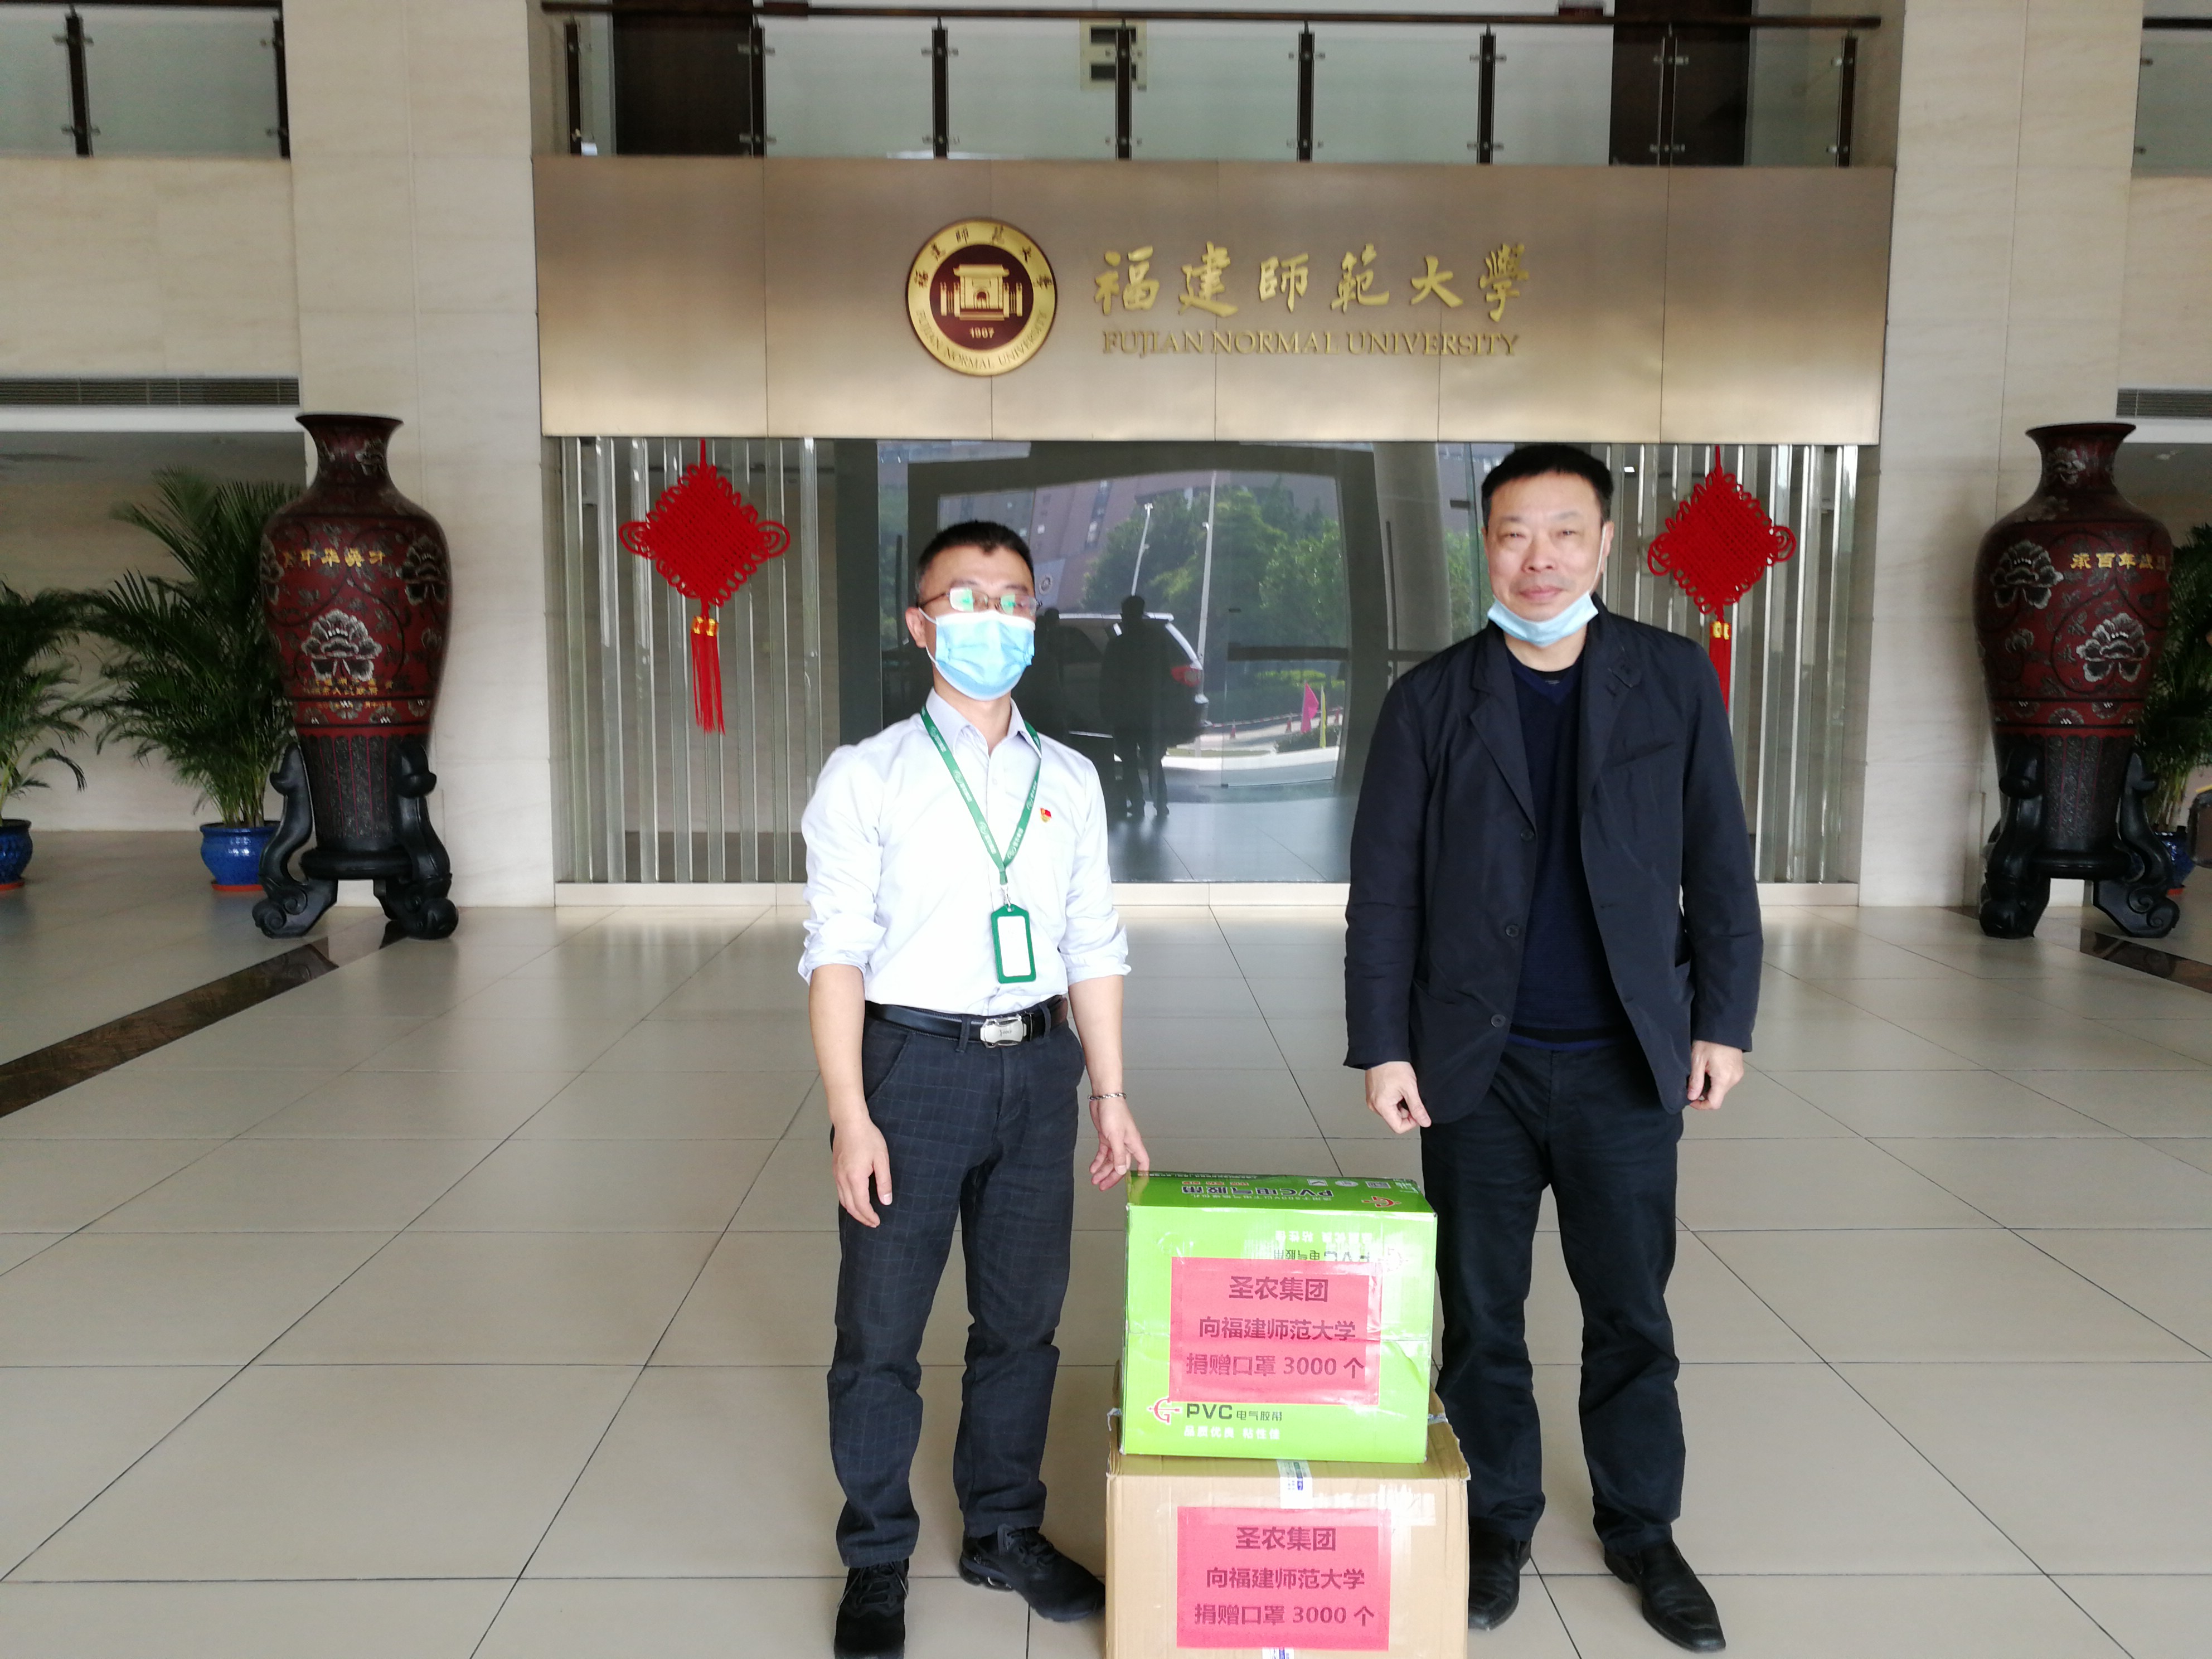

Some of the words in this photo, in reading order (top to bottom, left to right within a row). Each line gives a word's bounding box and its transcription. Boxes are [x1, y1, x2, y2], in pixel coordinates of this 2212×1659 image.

[1094, 241, 1529, 322] 福建師範大學
[945, 347, 996, 370] NORMAL
[998, 311, 1048, 367] UNIVERSITY
[969, 327, 995, 339] 1907
[1103, 330, 1204, 358] FUJIAN
[1211, 330, 1340, 355] NORMAL
[1347, 331, 1519, 356] UNIVERSITY
[1229, 1276, 1328, 1302] 圣农集团
[1199, 1317, 1356, 1341] 向福建师范大学
[1186, 1353, 1275, 1376] 捐赠口罩
[1283, 1357, 1337, 1375] 3000
[1343, 1357, 1365, 1379] 个
[1186, 1403, 1233, 1419] PVC
[1236, 1410, 1282, 1421] 电气胶带
[1235, 1527, 1336, 1551] 圣农集团
[1206, 1568, 1365, 1590] 向福建师范大学
[1195, 1604, 1284, 1626] 捐赠口罩
[1293, 1607, 1346, 1623] 3000
[1354, 1607, 1374, 1626] 个
